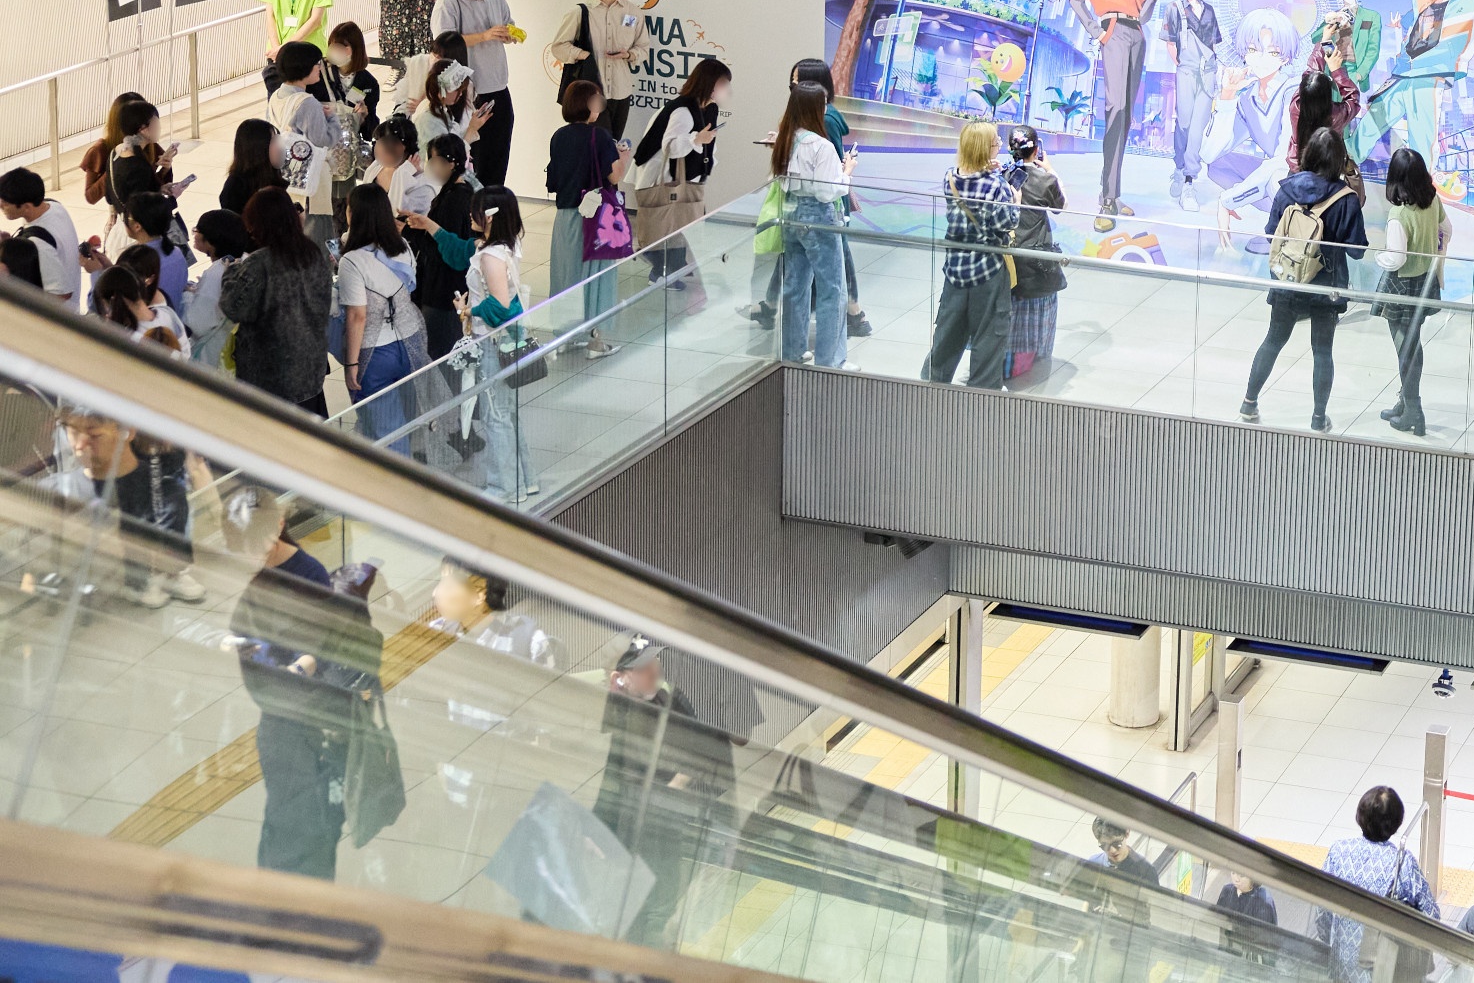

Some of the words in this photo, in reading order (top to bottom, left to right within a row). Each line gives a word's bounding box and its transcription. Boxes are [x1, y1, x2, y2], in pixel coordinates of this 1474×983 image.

[645, 15, 687, 47] MA
[661, 83, 677, 95] to
[718, 110, 732, 118] RIP
